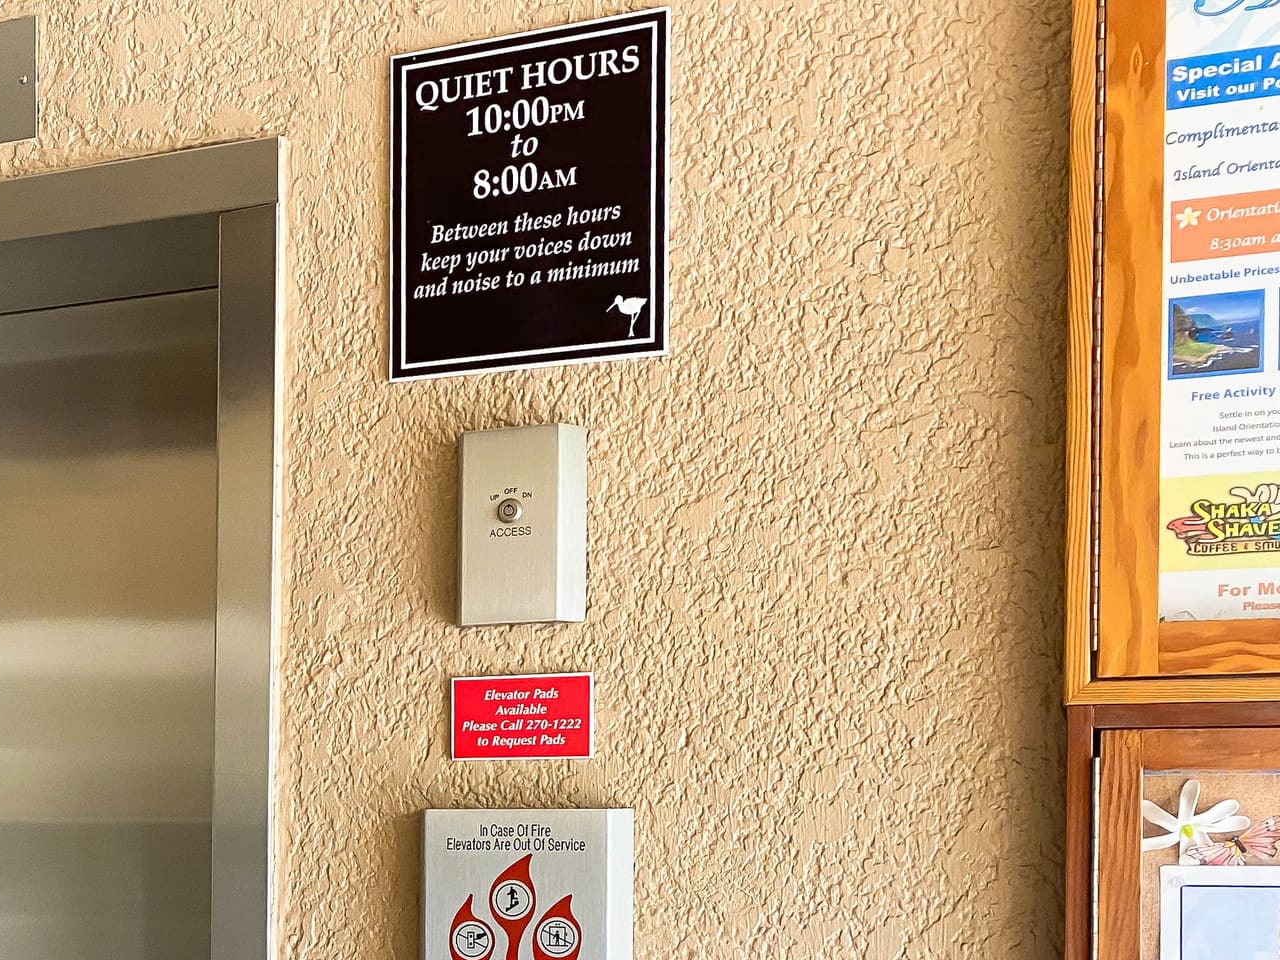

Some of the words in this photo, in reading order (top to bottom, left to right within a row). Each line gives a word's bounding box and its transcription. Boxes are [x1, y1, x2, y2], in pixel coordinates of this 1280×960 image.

[1172, 55, 1262, 84] Special
[415, 67, 514, 111] QUIET
[521, 45, 640, 91] HOURS
[1176, 85, 1220, 101] Visit
[1225, 82, 1256, 95] our
[466, 96, 585, 137] 10:00PM
[511, 134, 539, 158] to
[1173, 161, 1225, 181] Island
[473, 162, 577, 199] 8:00AM
[431, 220, 508, 244] Between
[514, 212, 562, 233] these
[566, 205, 621, 226] hours
[1210, 234, 1266, 252] 8:30am
[421, 252, 461, 274] keep
[466, 247, 510, 272] your
[513, 238, 572, 260] voices
[578, 231, 632, 252] down
[413, 277, 449, 300] and
[451, 273, 500, 295] noise
[506, 270, 525, 288] to
[530, 270, 542, 285] a
[547, 257, 641, 283] minimum
[1170, 269, 1241, 285] Unbeatable
[1244, 265, 1280, 278] Prices
[1191, 391, 1220, 401] Free
[1223, 386, 1277, 398] Activity
[1219, 411, 1243, 419] Settle
[1212, 424, 1237, 432] Island
[1169, 441, 1192, 449] Learn
[1193, 439, 1217, 447] about
[1219, 437, 1233, 445] the
[1184, 452, 1200, 460] This
[1216, 449, 1245, 460] perfect
[1192, 499, 1273, 522] SHAKA
[489, 526, 532, 537] ACCESS
[1193, 543, 1238, 553] COFFEE
[1217, 584, 1252, 597] For
[484, 689, 530, 701] Elevator
[533, 688, 559, 699] Pads
[495, 704, 547, 715] Available
[462, 720, 498, 732] Please
[500, 719, 523, 730] Call
[526, 719, 581, 730] 270-1222
[477, 737, 489, 746] to
[492, 735, 537, 748] Request
[540, 734, 566, 745] Pads
[480, 824, 488, 837] In
[490, 824, 514, 837] Case
[517, 824, 529, 837] Of
[531, 824, 551, 837] Fire
[446, 838, 491, 850] Elevators
[493, 838, 511, 850] Are
[513, 838, 531, 851] Out
[534, 838, 545, 850] Of
[548, 838, 586, 851] Service
